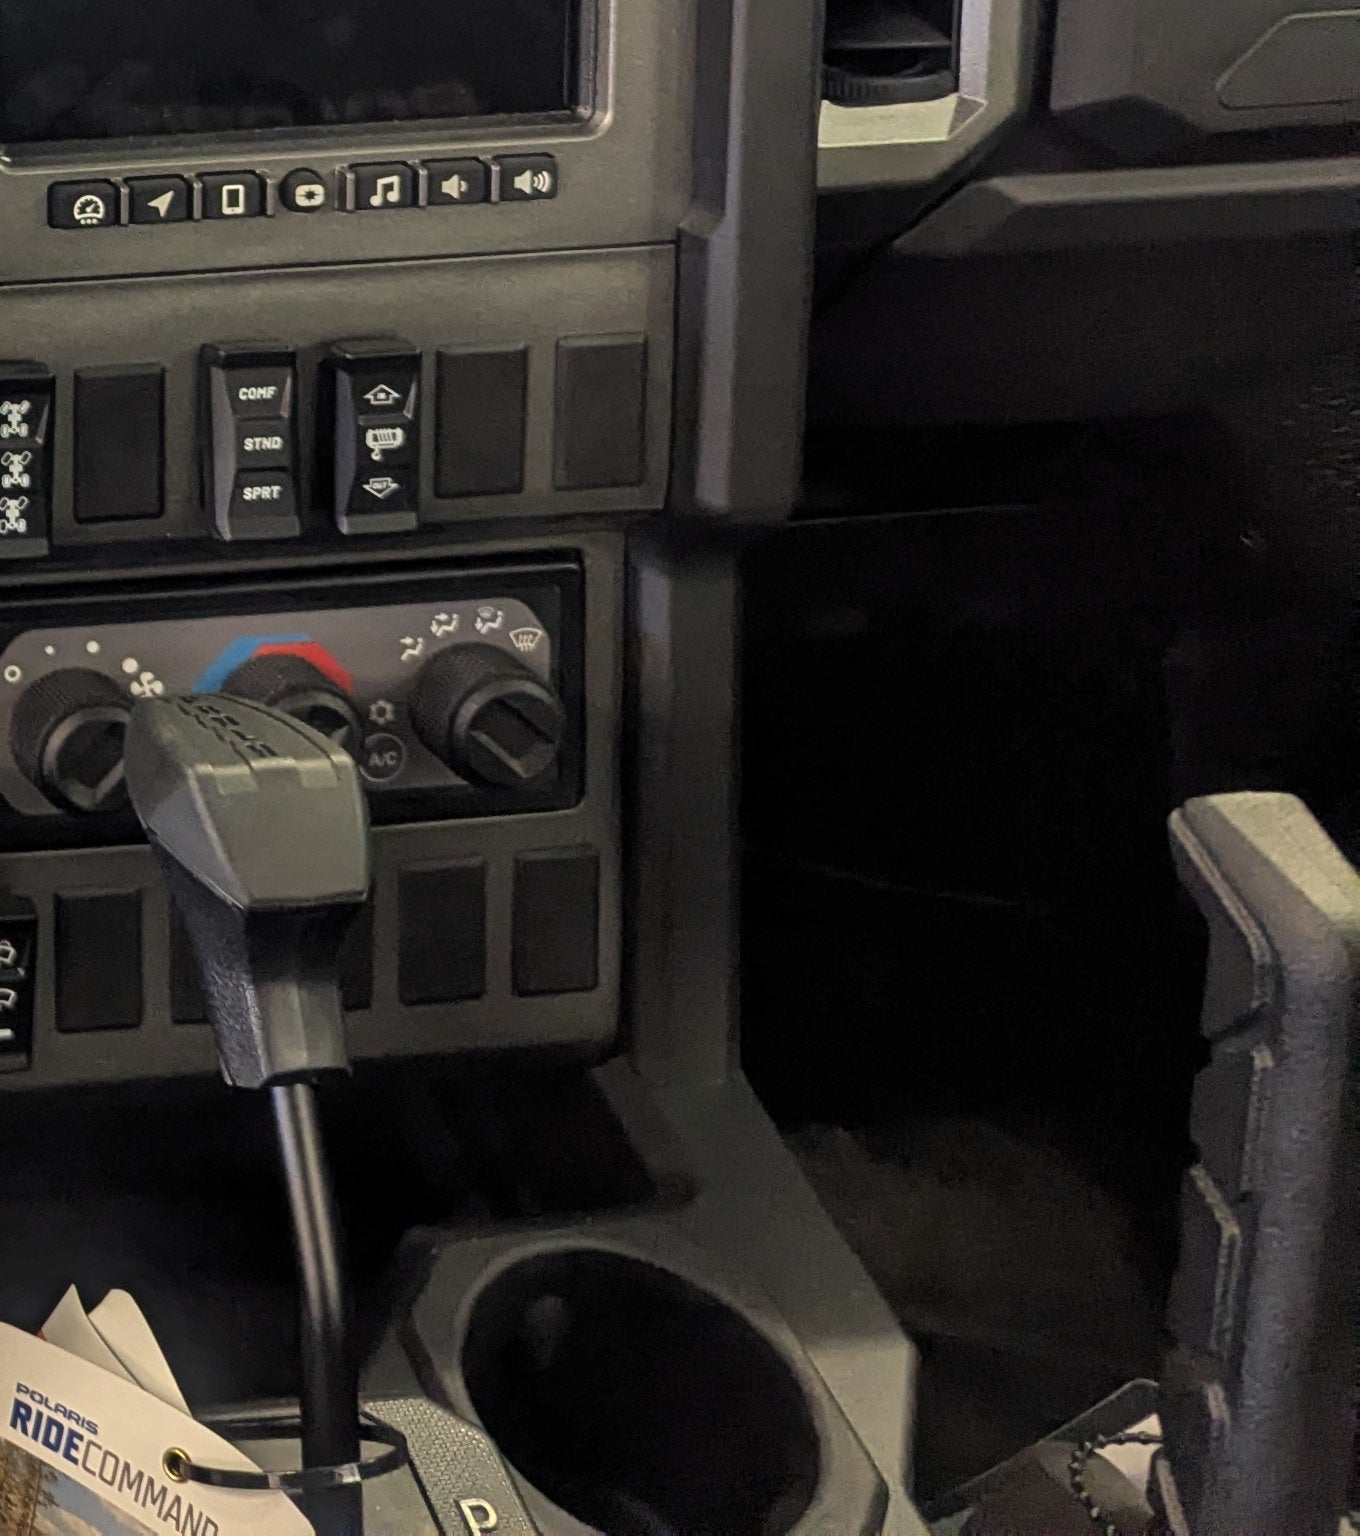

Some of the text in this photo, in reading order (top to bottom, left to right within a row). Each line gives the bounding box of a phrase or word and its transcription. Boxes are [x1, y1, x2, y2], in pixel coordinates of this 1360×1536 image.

[238, 385, 278, 401] COMF
[243, 435, 284, 452] STND
[242, 484, 282, 501] SPRT
[368, 750, 398, 767] A/C
[15, 1382, 100, 1437] POLARIS
[459, 1497, 498, 1536] P
